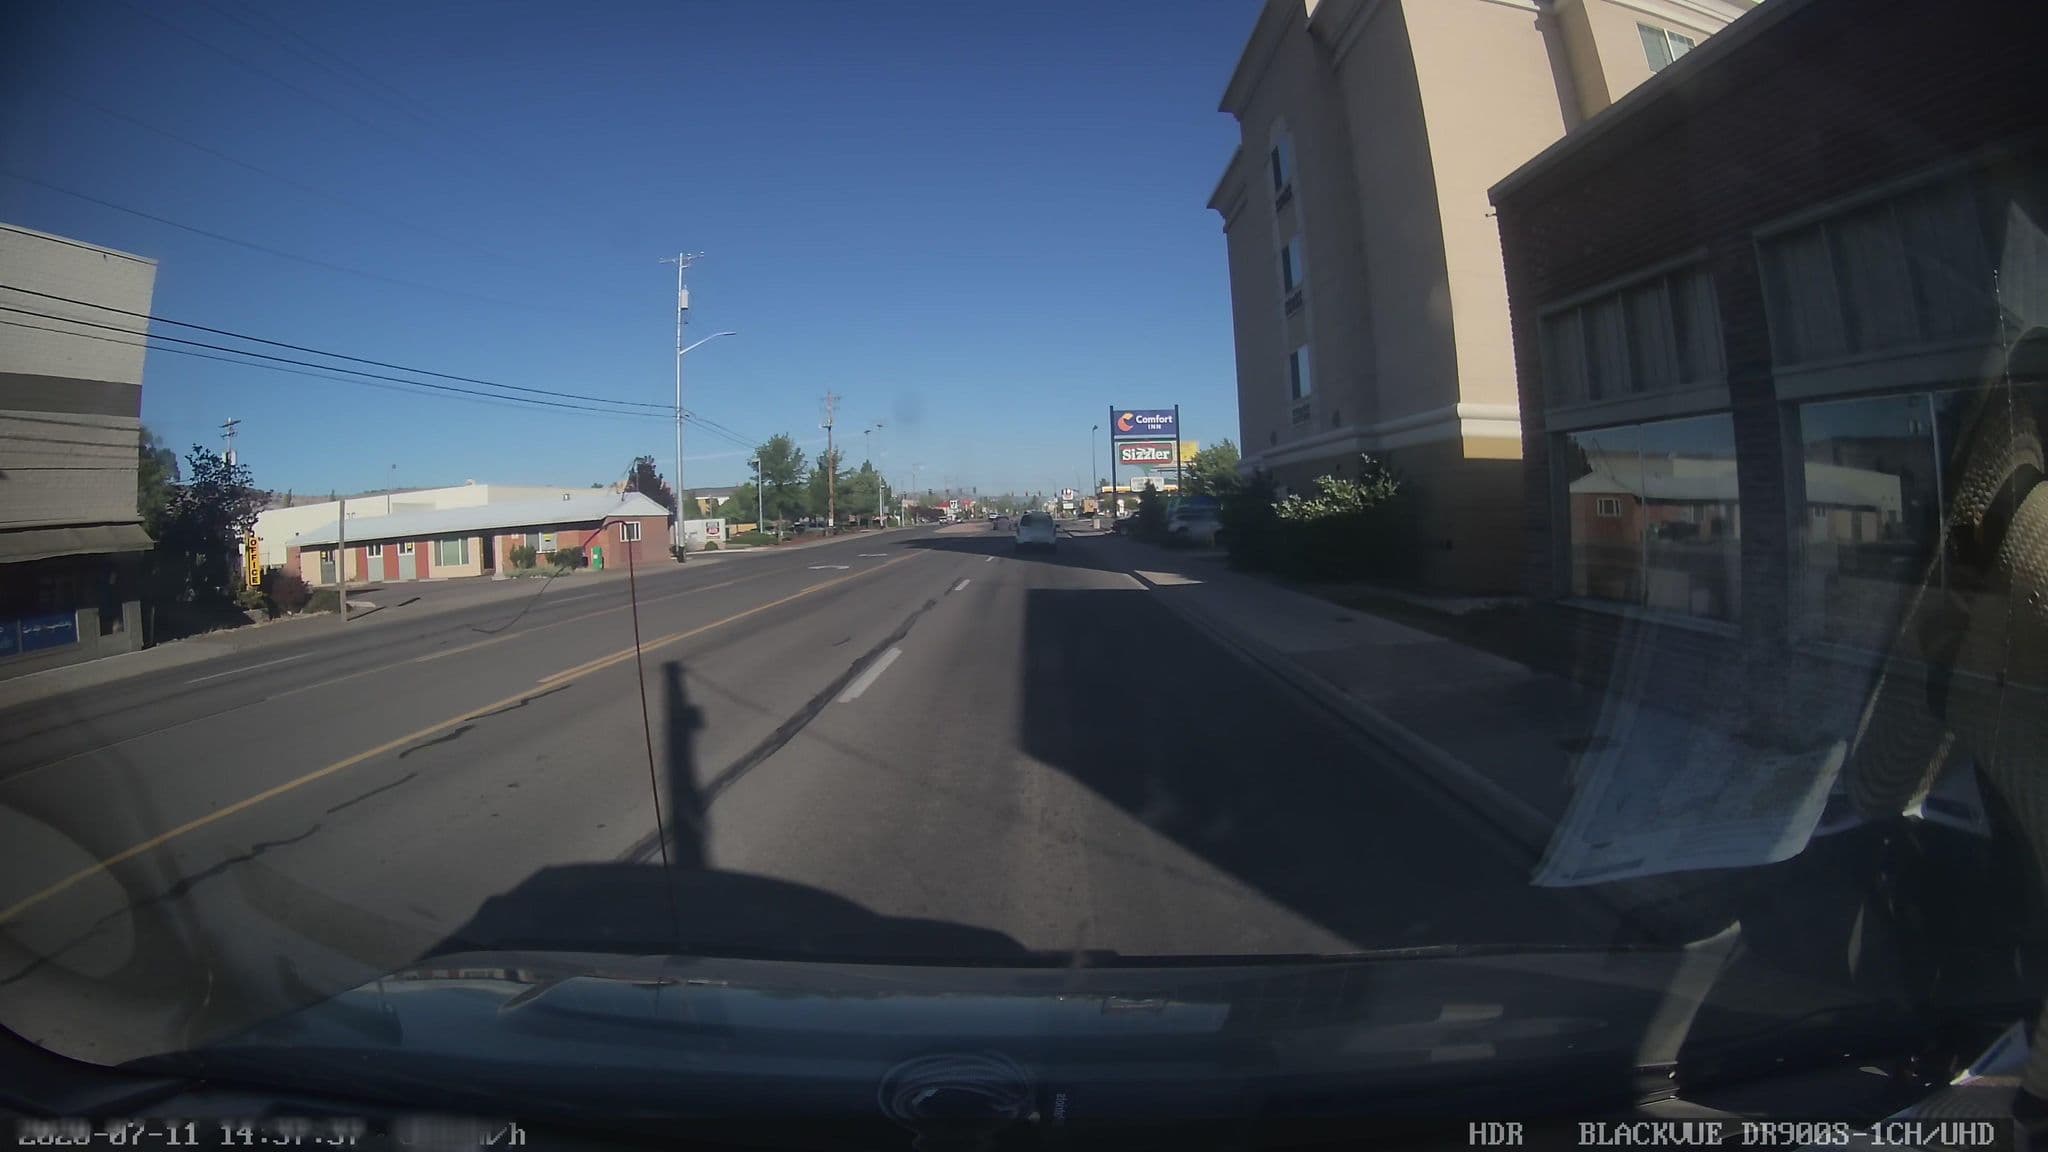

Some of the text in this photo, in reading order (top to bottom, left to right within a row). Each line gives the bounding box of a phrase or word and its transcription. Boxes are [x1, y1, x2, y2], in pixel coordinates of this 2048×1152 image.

[1135, 414, 1173, 424] Comfort
[1122, 447, 1170, 461] Sizzler
[250, 539, 259, 584] OFFICE
